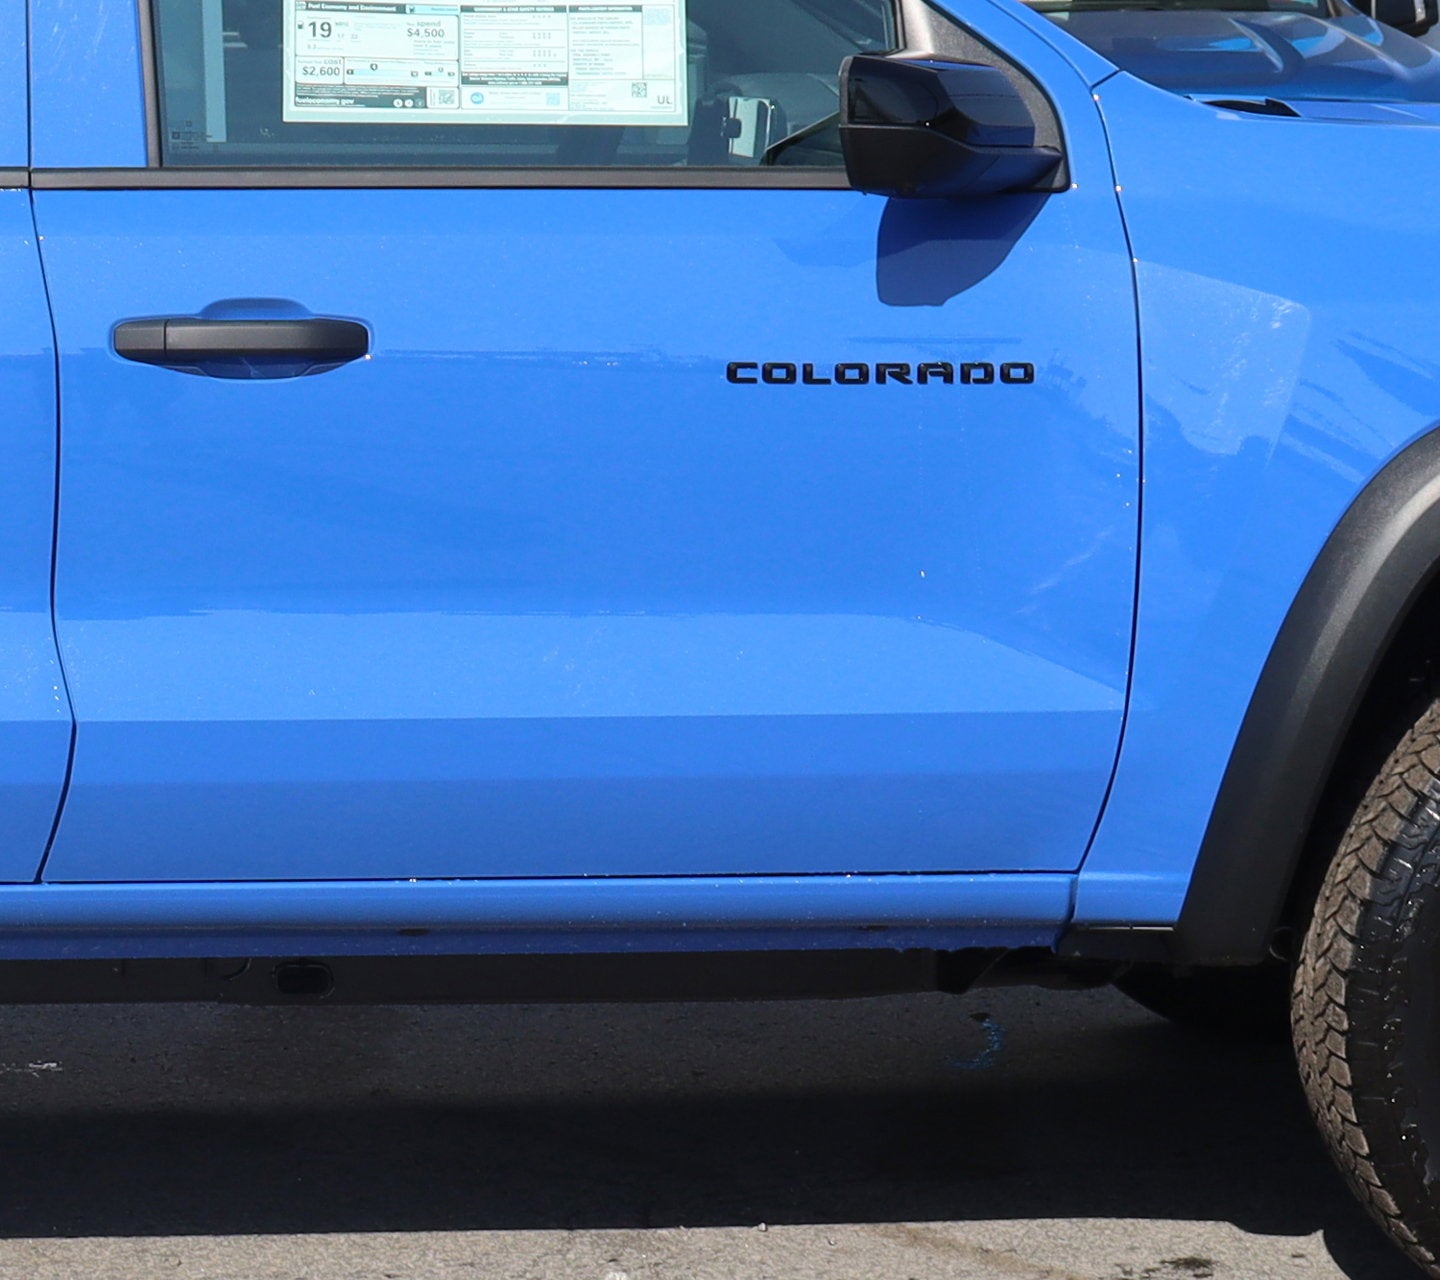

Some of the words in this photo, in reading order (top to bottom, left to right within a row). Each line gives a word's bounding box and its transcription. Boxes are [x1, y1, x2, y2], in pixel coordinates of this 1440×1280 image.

[308, 21, 332, 38] 19
[406, 28, 445, 38] $4,500
[302, 66, 341, 76] $2,600
[726, 361, 1035, 385] COLORADO
